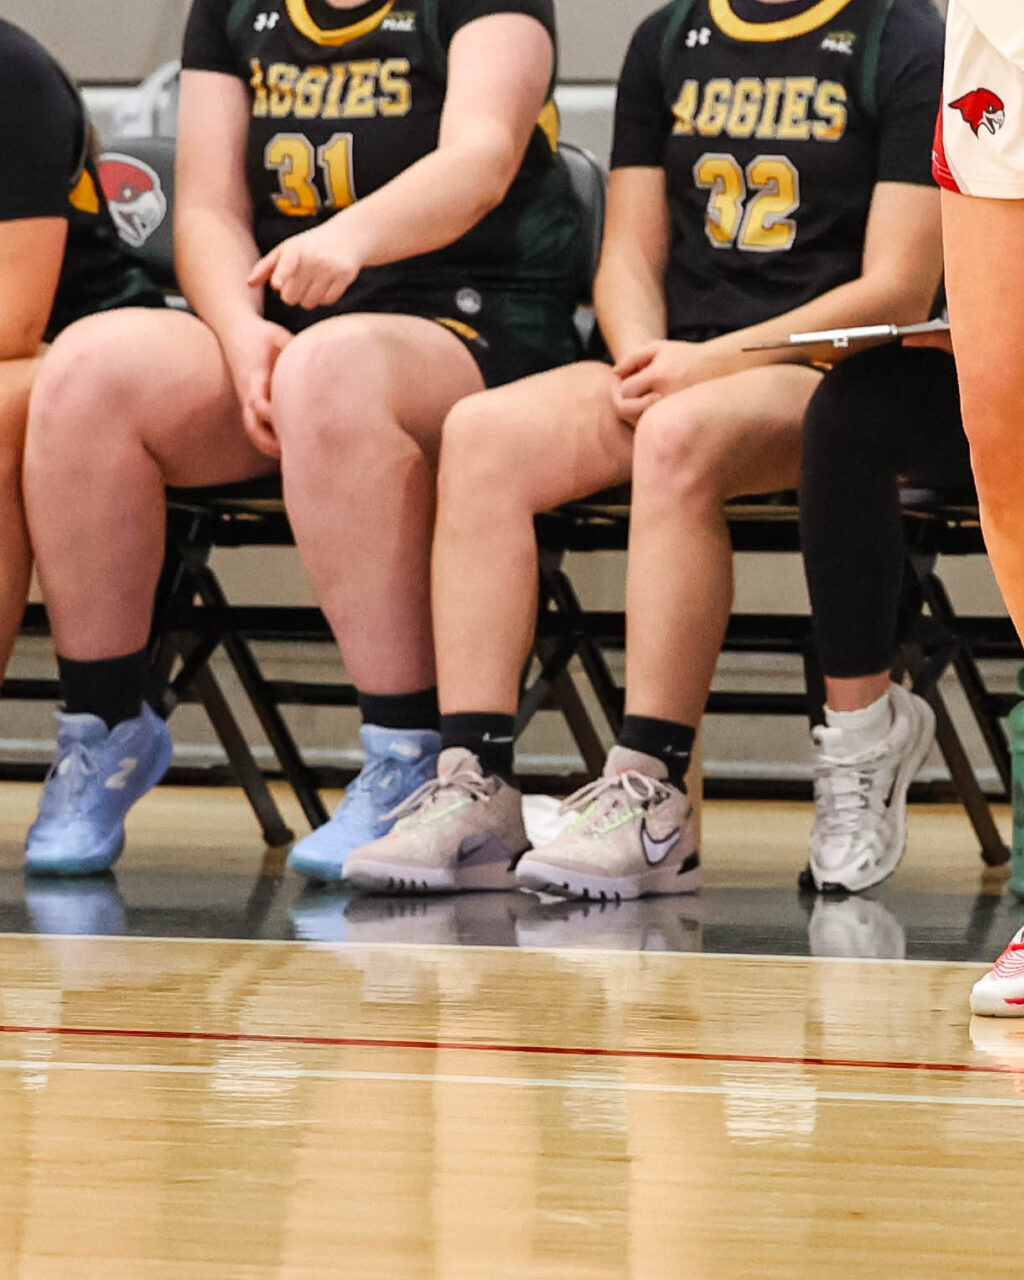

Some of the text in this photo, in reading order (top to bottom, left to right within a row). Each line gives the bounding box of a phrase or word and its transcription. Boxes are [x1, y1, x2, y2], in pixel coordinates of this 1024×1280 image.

[671, 76, 847, 141] AGGIES
[264, 132, 357, 217] 31
[693, 153, 800, 252] 32
